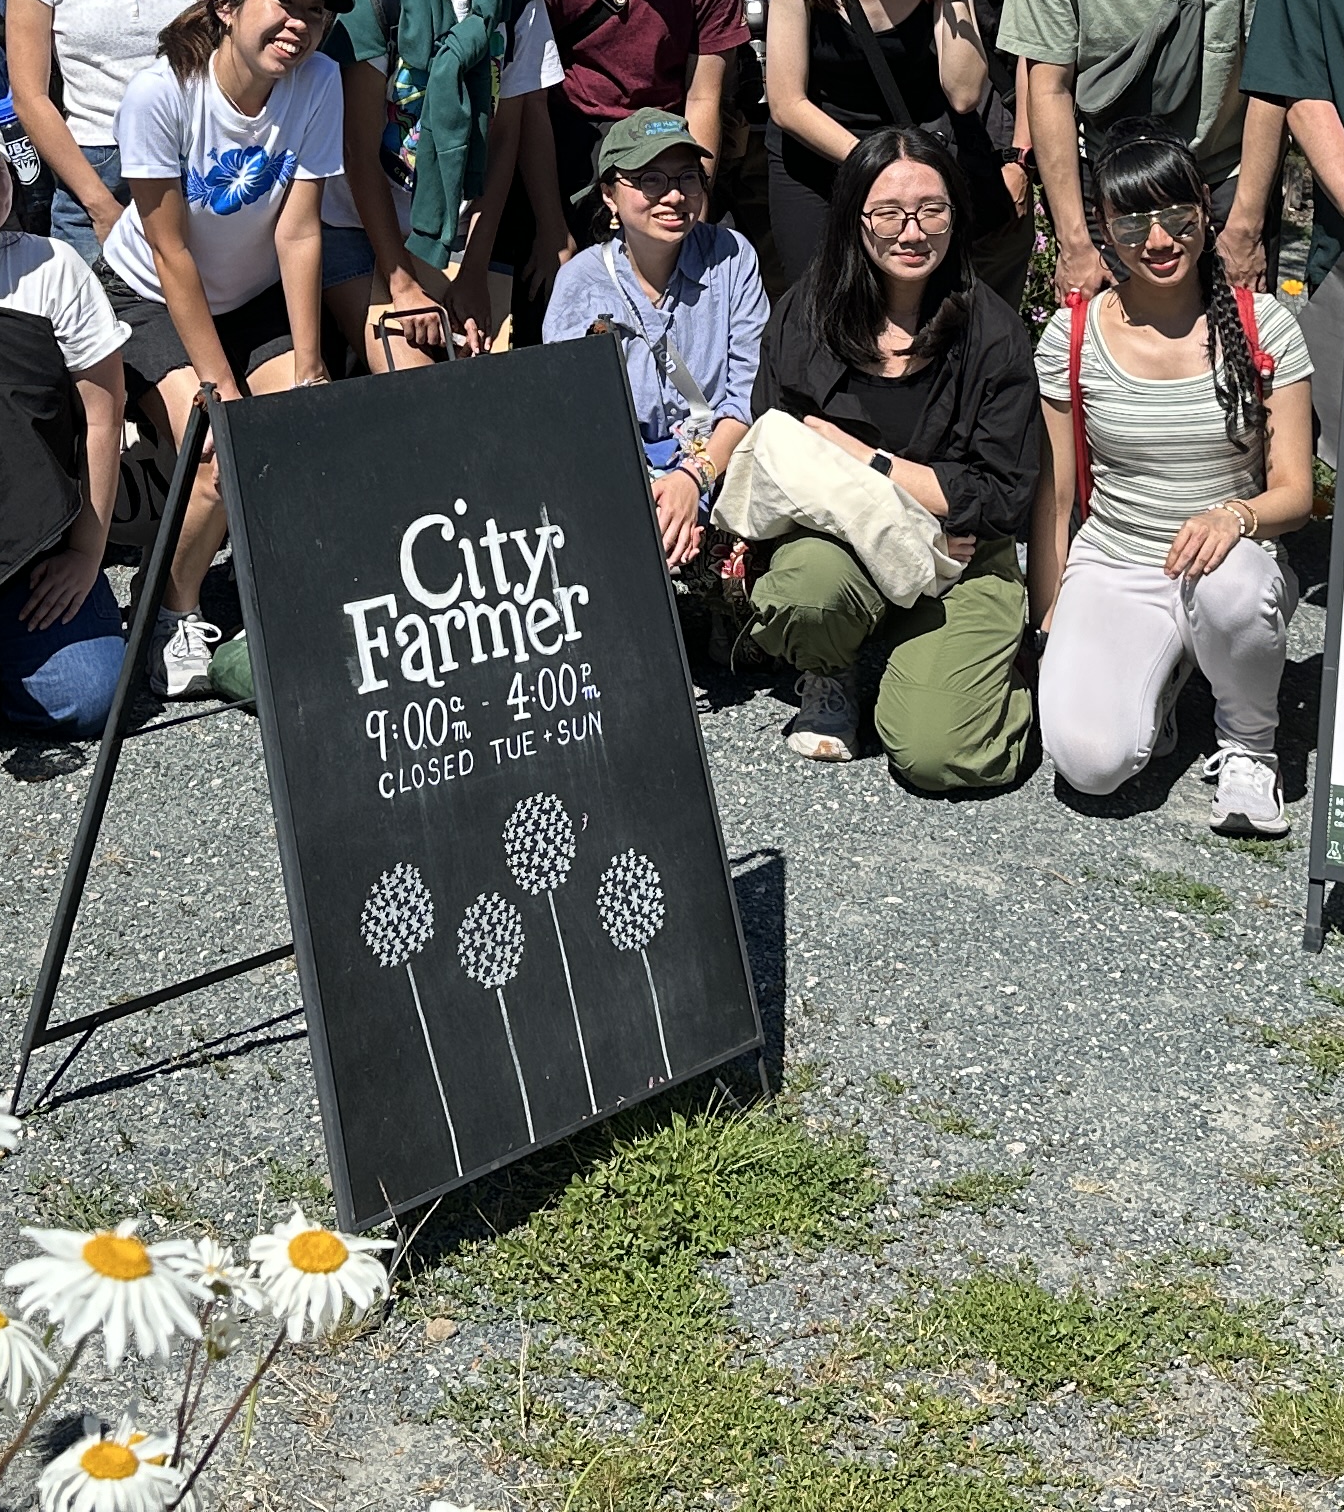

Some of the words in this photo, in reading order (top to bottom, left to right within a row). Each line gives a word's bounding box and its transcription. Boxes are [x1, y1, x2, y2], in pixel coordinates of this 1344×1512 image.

[655, 341, 677, 374] non
[399, 497, 566, 610] City
[343, 583, 590, 695] Farmer
[377, 748, 475, 799] CLOSED
[488, 729, 538, 766] TUE
[556, 710, 604, 747] SUN
[1334, 808, 1344, 818] By
